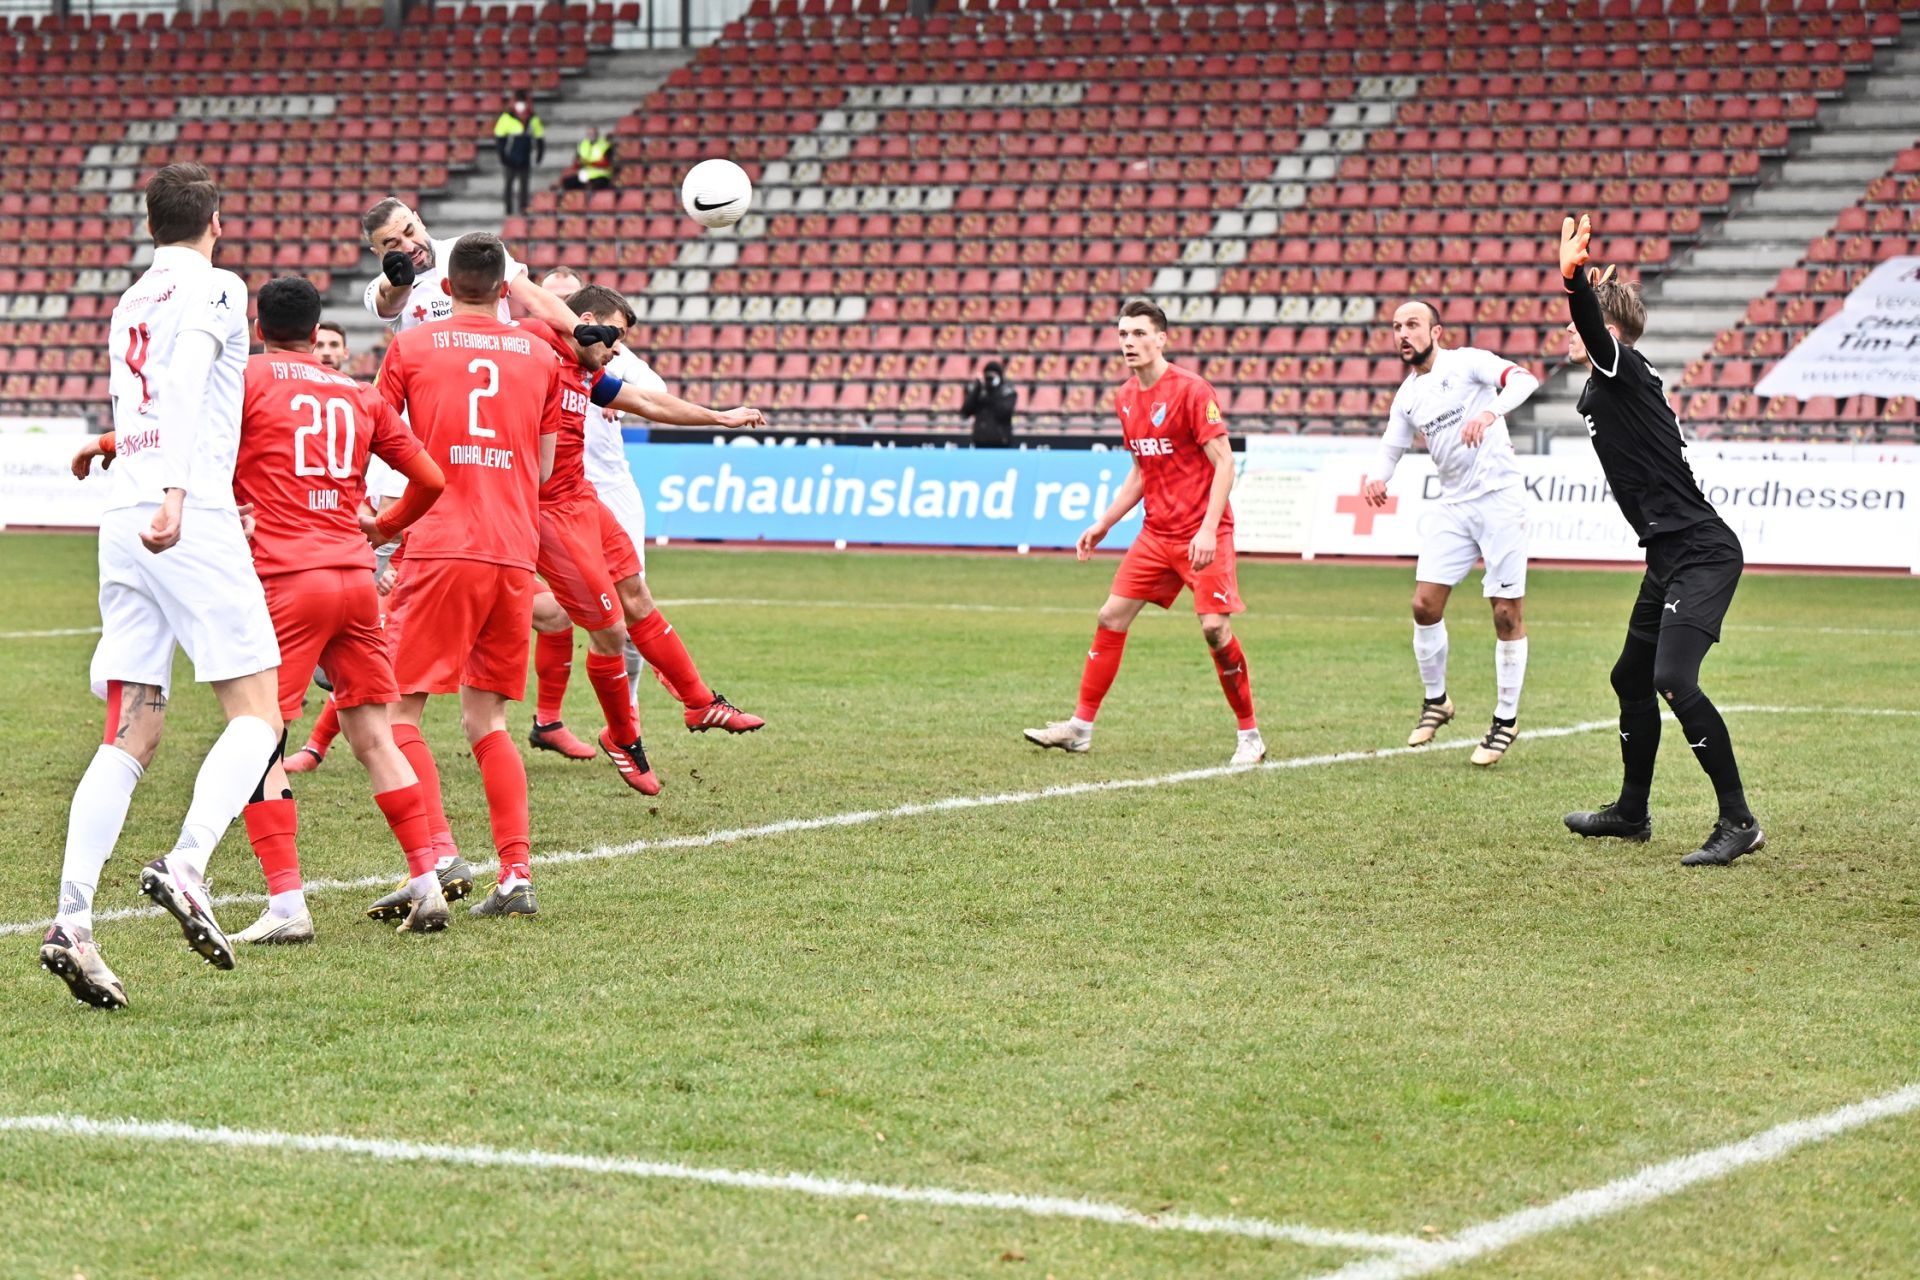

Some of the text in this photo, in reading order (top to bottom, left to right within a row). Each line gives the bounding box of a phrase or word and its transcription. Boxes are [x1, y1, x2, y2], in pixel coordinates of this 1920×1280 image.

[432, 332, 531, 355] TSV STEINBACH HAIGER
[270, 361, 289, 380] TSV
[468, 357, 499, 438] 2
[290, 393, 356, 479] 20
[450, 445, 513, 470] MIHALJEVIC
[308, 489, 339, 510] ILHAN
[655, 462, 1018, 520] schauinsland
[600, 592, 613, 612] 6
